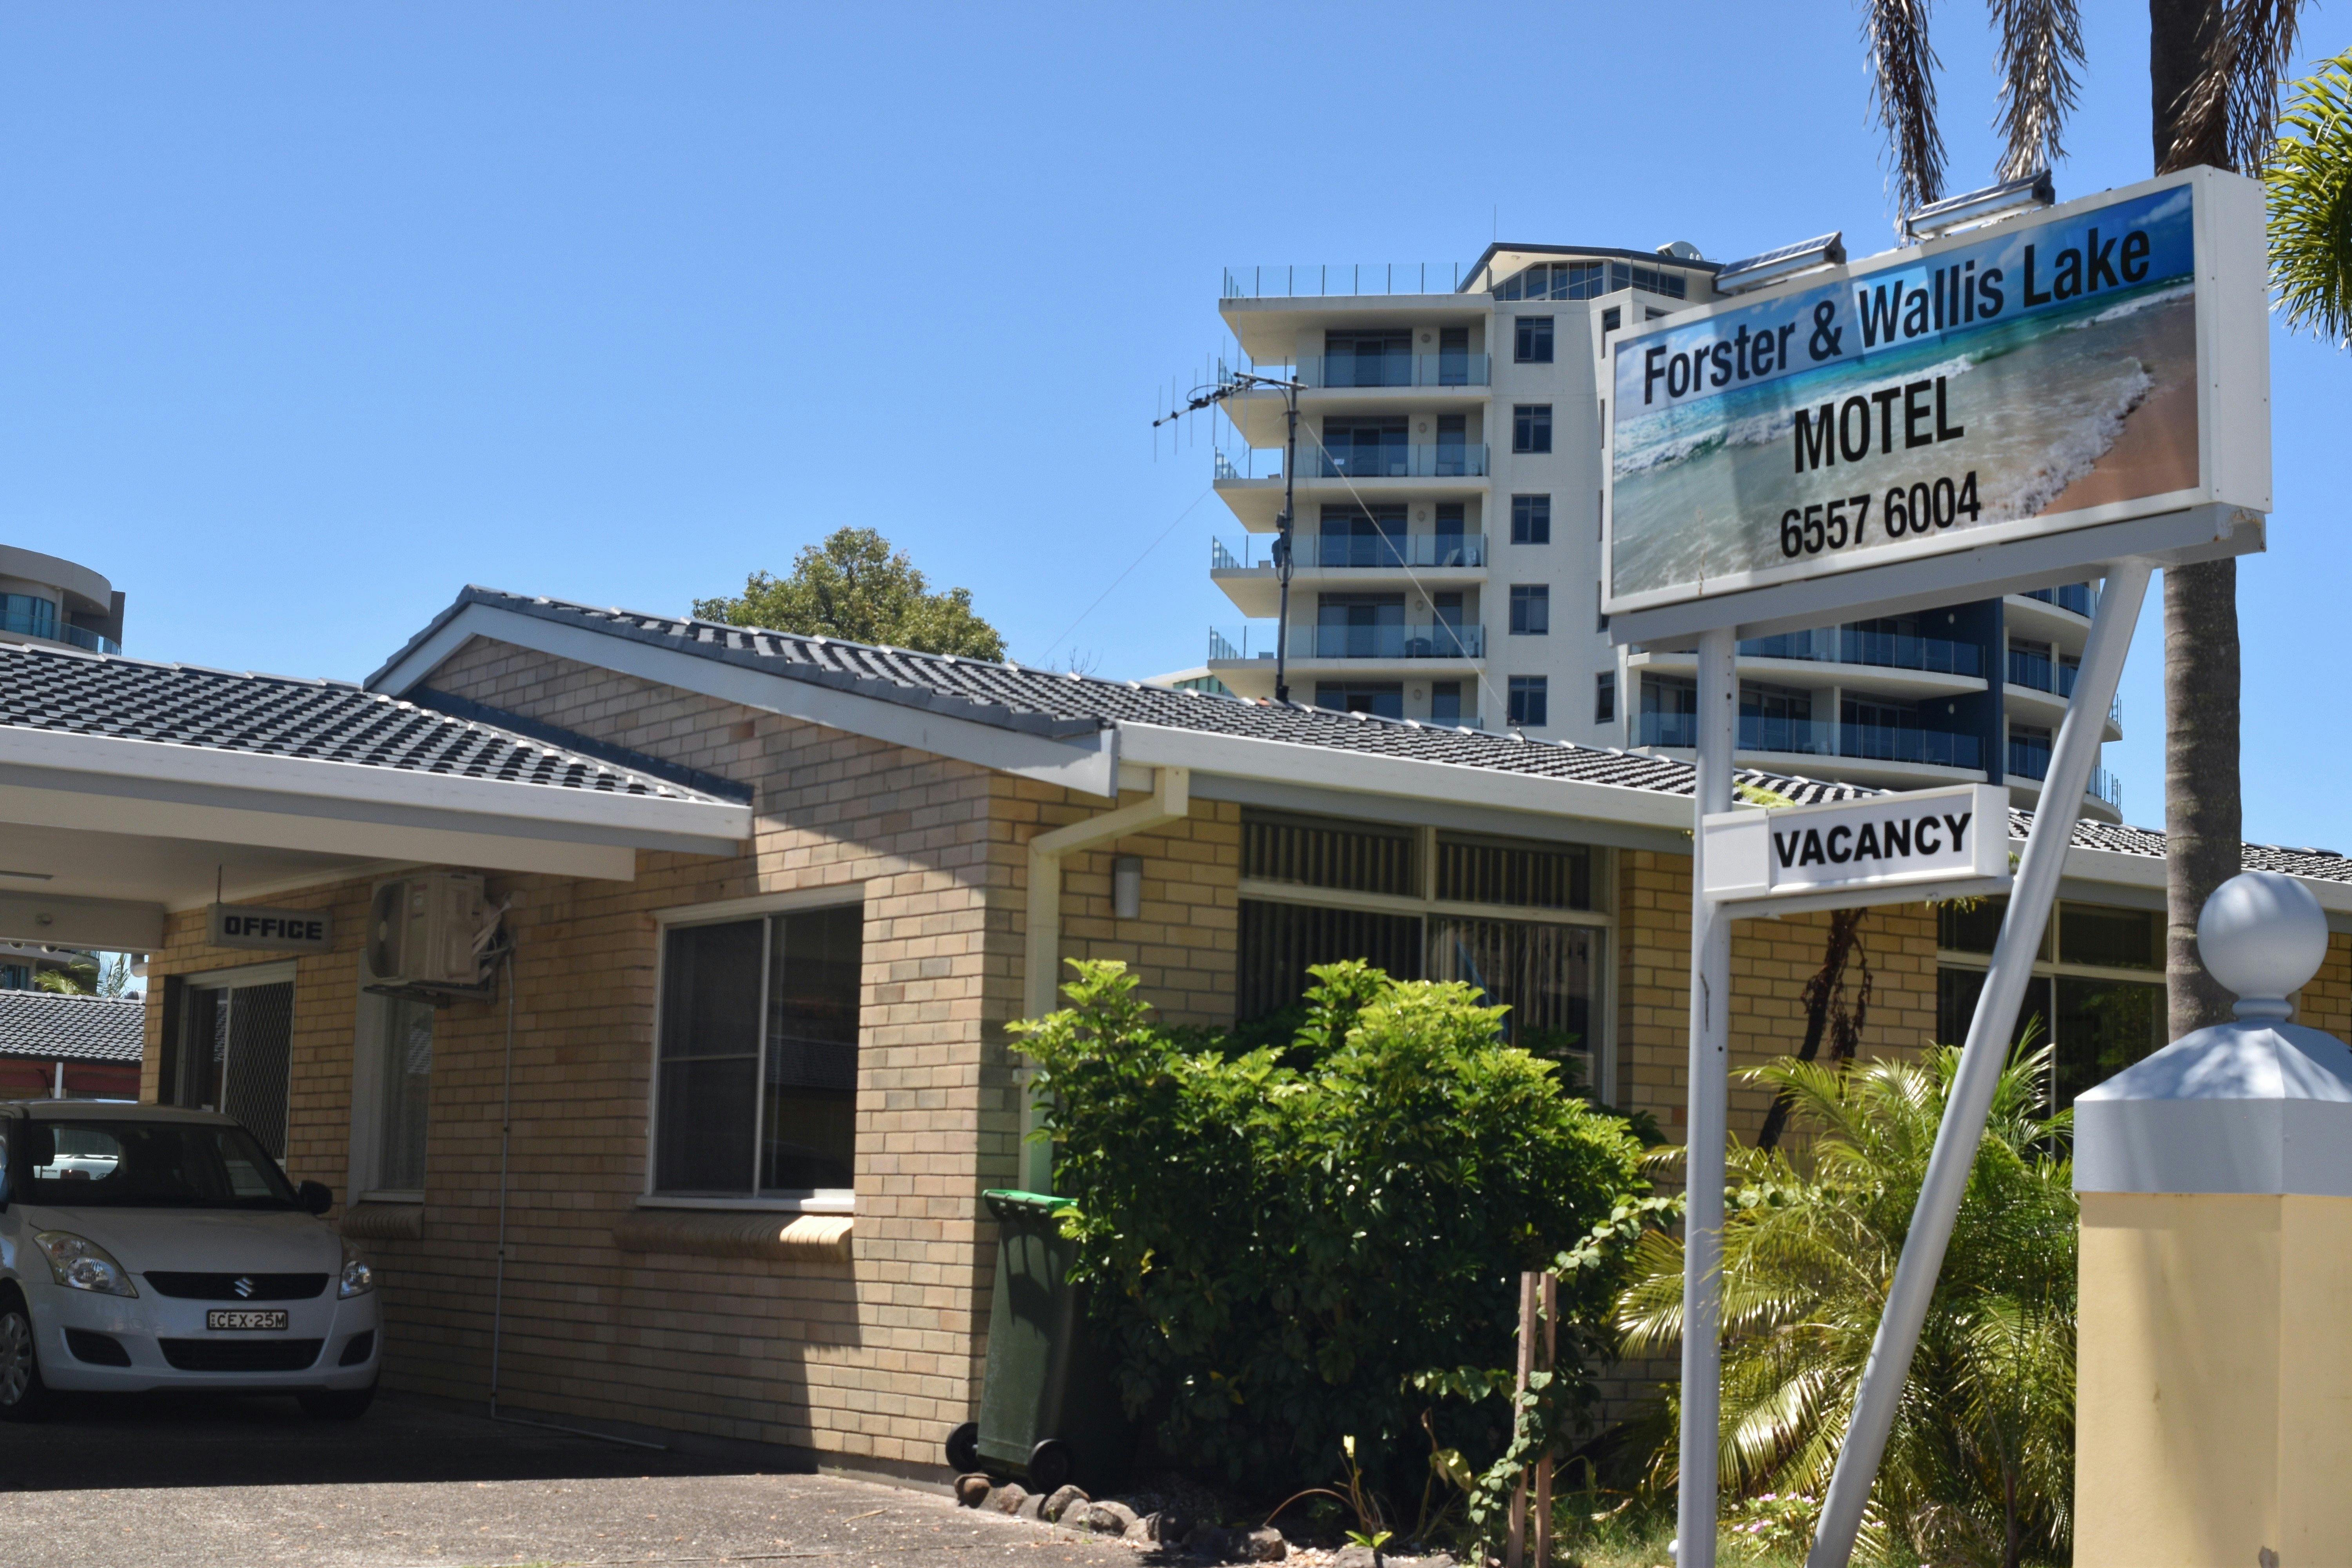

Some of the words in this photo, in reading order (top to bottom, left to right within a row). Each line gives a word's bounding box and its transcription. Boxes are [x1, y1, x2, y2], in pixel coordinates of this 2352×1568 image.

[1644, 321, 1795, 405] Forster
[1808, 301, 1842, 361] &
[1858, 260, 2004, 348] Wallis
[2023, 227, 2150, 308] Lake
[1794, 376, 1964, 474] MOTEL
[1780, 494, 1871, 558] 6557
[1884, 471, 1981, 539] 6004
[1773, 812, 1972, 868] VACANCY
[224, 915, 323, 940] OFFICE
